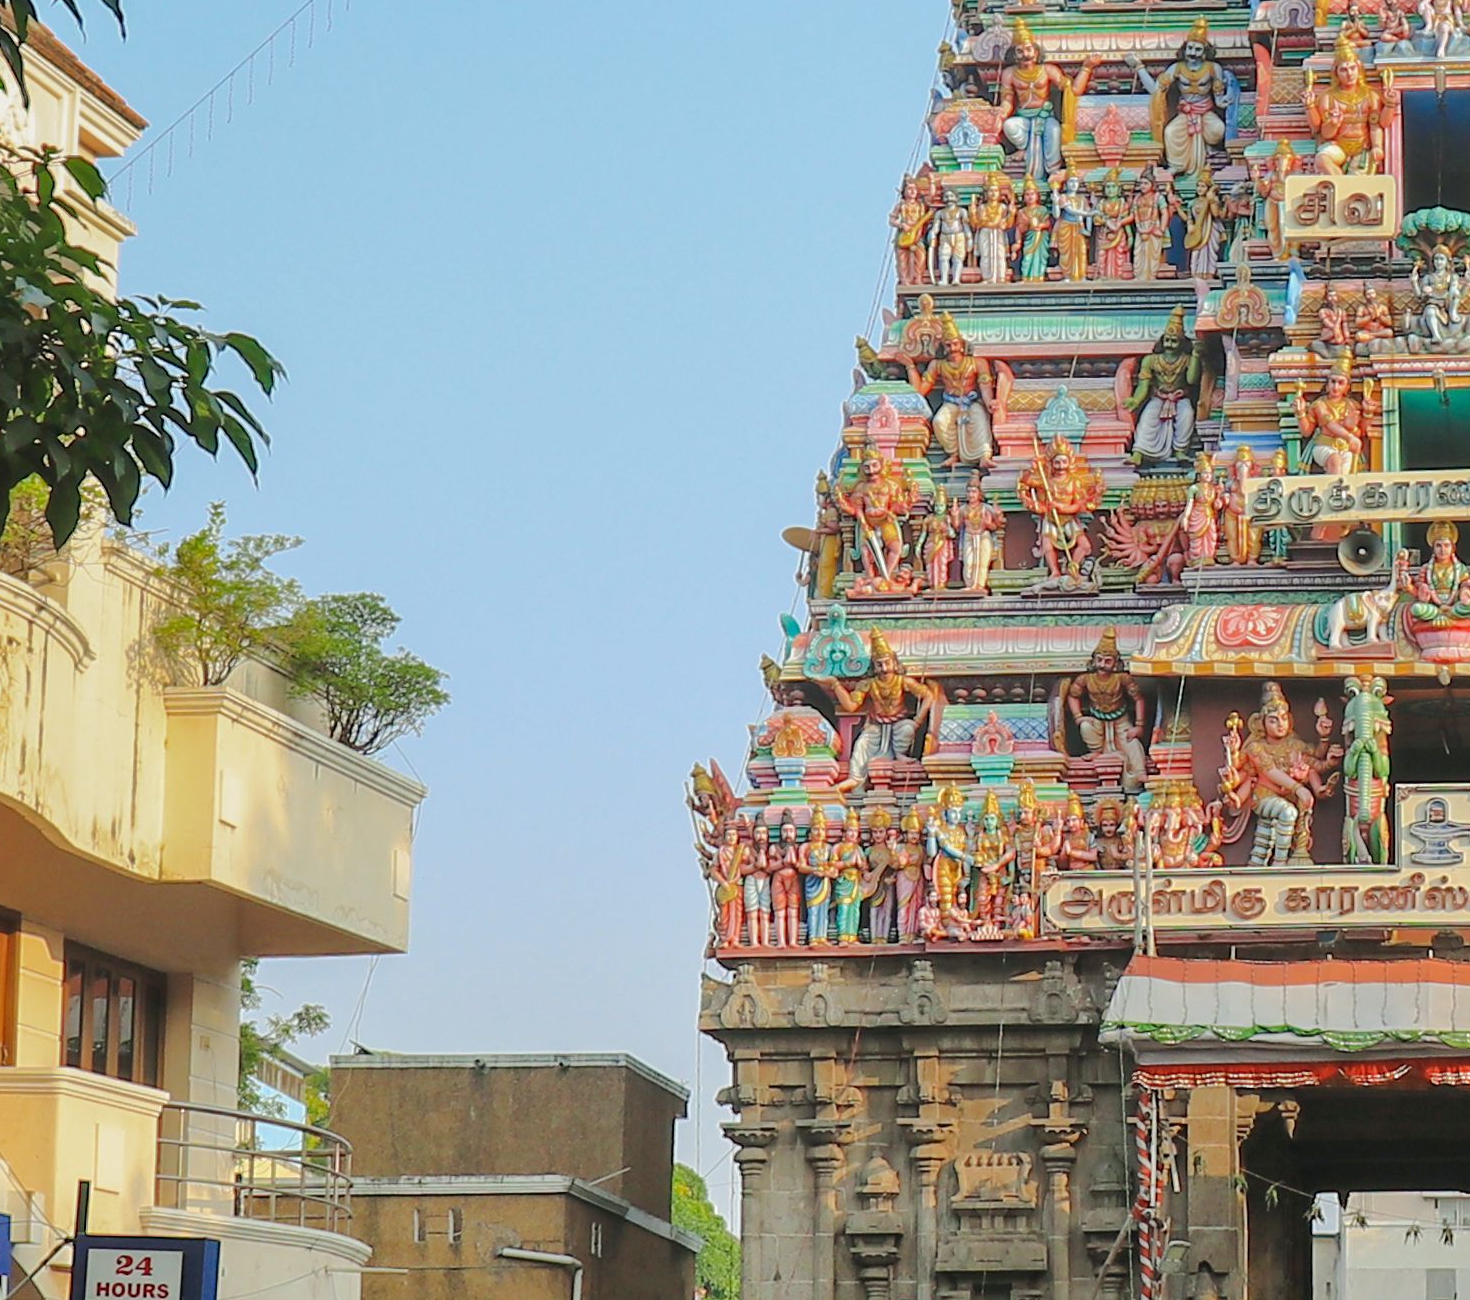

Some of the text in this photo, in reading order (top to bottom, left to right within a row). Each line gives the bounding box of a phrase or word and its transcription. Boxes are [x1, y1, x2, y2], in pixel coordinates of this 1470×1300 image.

[1294, 181, 1384, 228] சிவ
[1059, 877, 1268, 923] அருள்மிகு
[116, 1256, 154, 1277] 24
[96, 1281, 170, 1300] HOURS
